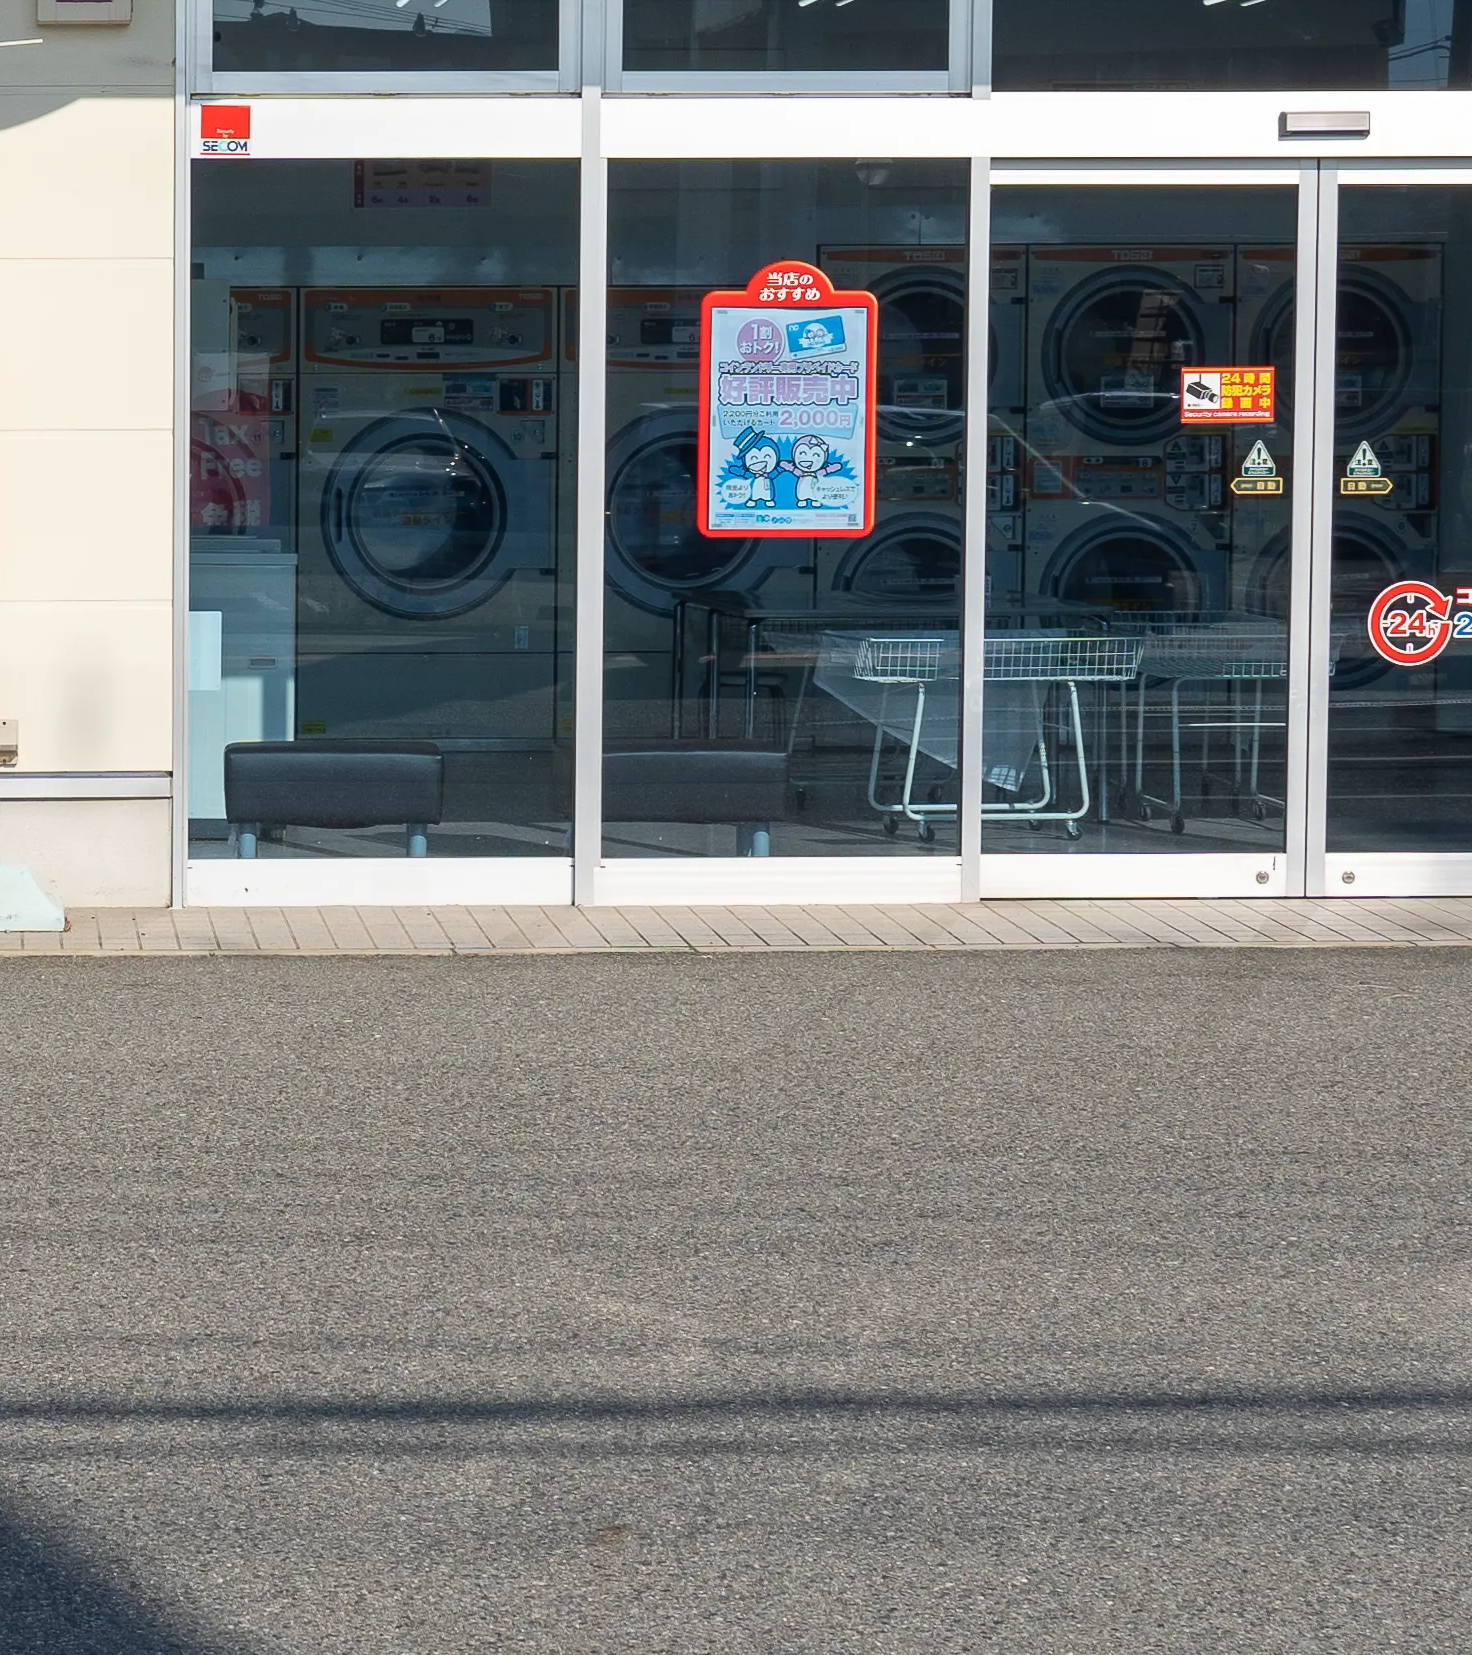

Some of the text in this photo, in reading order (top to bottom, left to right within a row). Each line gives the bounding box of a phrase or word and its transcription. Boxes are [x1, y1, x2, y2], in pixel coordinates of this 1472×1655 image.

[202, 140, 248, 153] SECOM
[766, 272, 814, 286] 当店の
[758, 288, 821, 302] おすすめ
[719, 373, 859, 406] 好評販売中
[1221, 384, 1272, 397] 防犯カメラ
[778, 409, 852, 429] 2,000円
[1184, 410, 1212, 418] Security
[202, 420, 251, 445] Tax
[200, 451, 263, 480] Free
